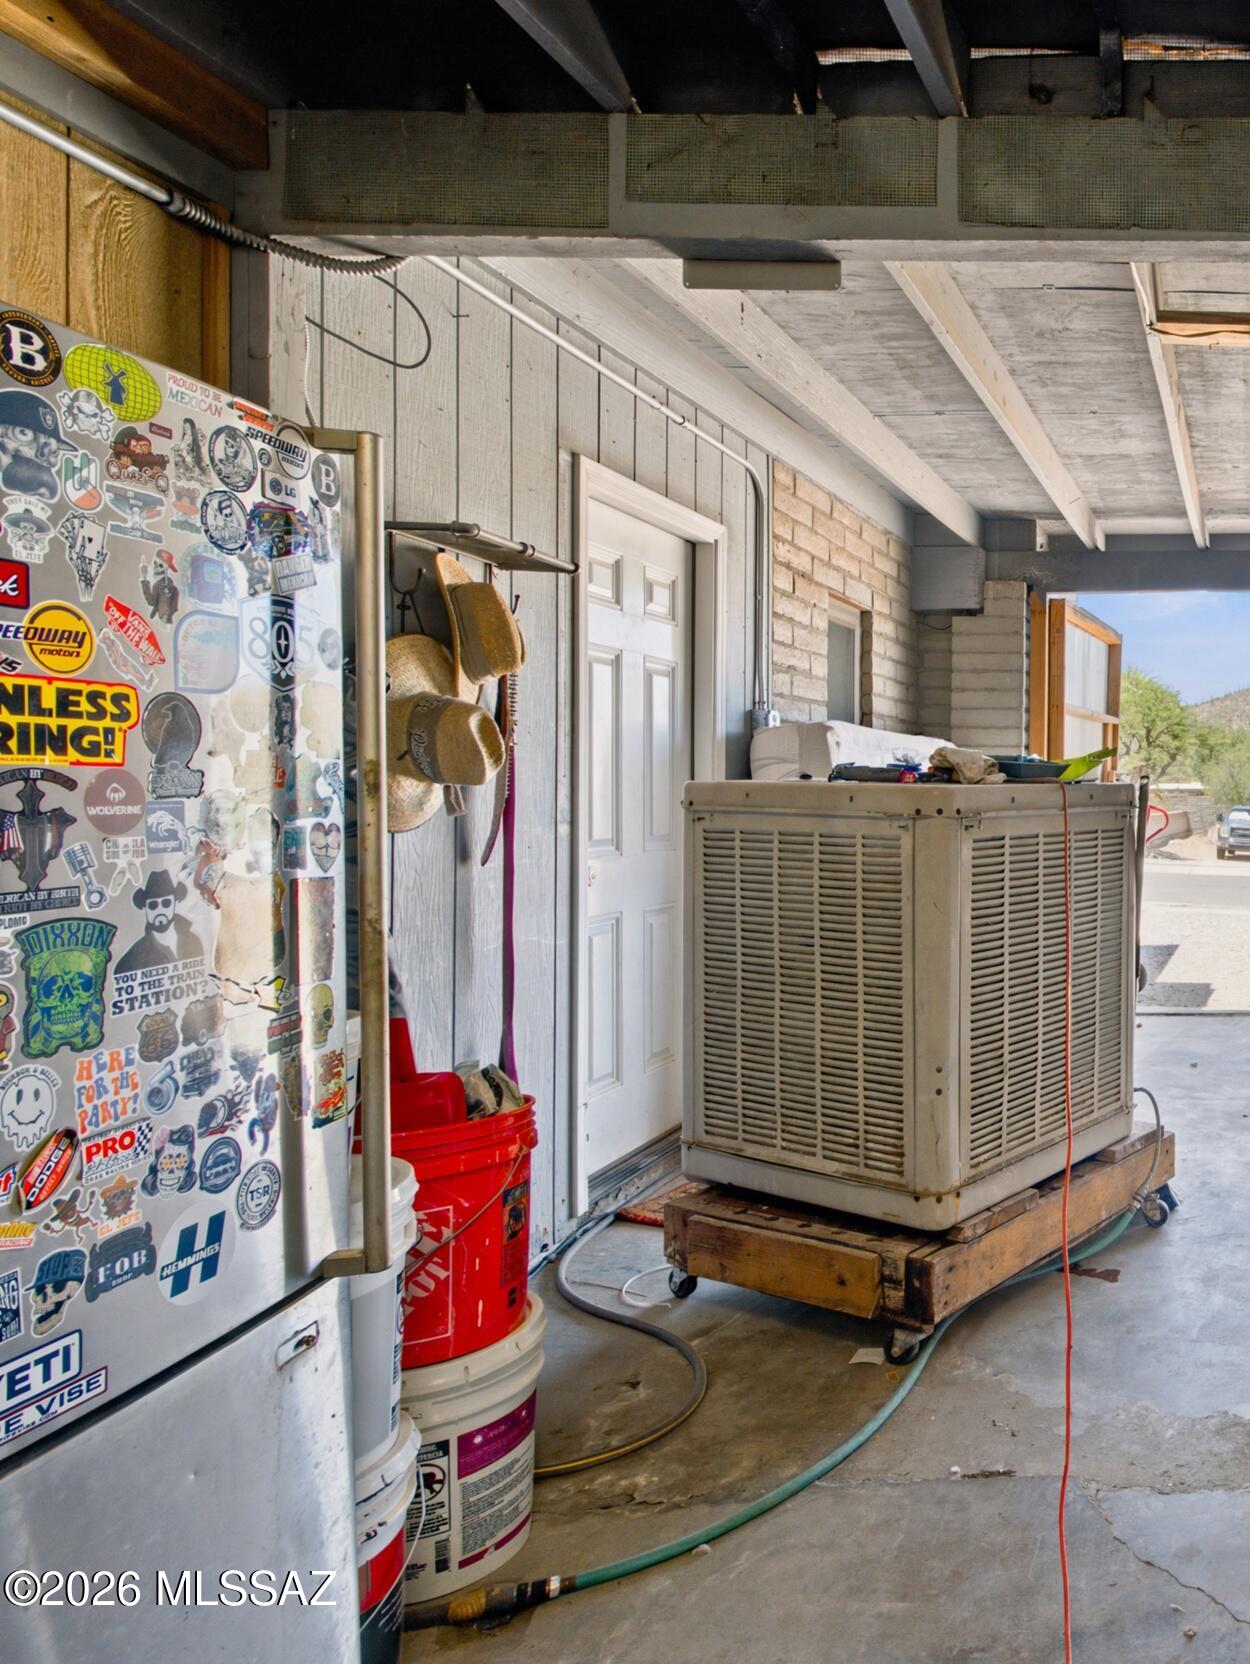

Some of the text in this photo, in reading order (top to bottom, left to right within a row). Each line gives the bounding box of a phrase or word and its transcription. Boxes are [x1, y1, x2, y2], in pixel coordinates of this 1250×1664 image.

[6, 323, 47, 372] B
[168, 373, 198, 392] PROUD
[200, 385, 210, 398] TO
[168, 388, 223, 417] MEXICAN
[245, 426, 308, 462] SPEEDWAY
[284, 485, 296, 498] LG
[319, 464, 336, 496] B
[0, 624, 87, 648] EEDWAY
[122, 622, 141, 647] THE
[127, 610, 149, 638] VANS
[86, 805, 142, 815] WOLVERINE
[23, 920, 116, 955] DIXXON
[113, 958, 206, 986] YOU NEED A RIDE
[115, 968, 206, 997] TO THE TRAIN
[112, 980, 209, 1016] STATION?
[75, 1046, 136, 1082] HERE
[76, 1071, 139, 1109] FOR THE
[77, 1092, 140, 1135] PARTY!
[84, 1130, 136, 1165] PRO
[28, 1135, 72, 1202] DODGE
[249, 1185, 270, 1202] TSR
[161, 1242, 220, 1277] HEMMINGS
[35, 1373, 102, 1416] VISE
